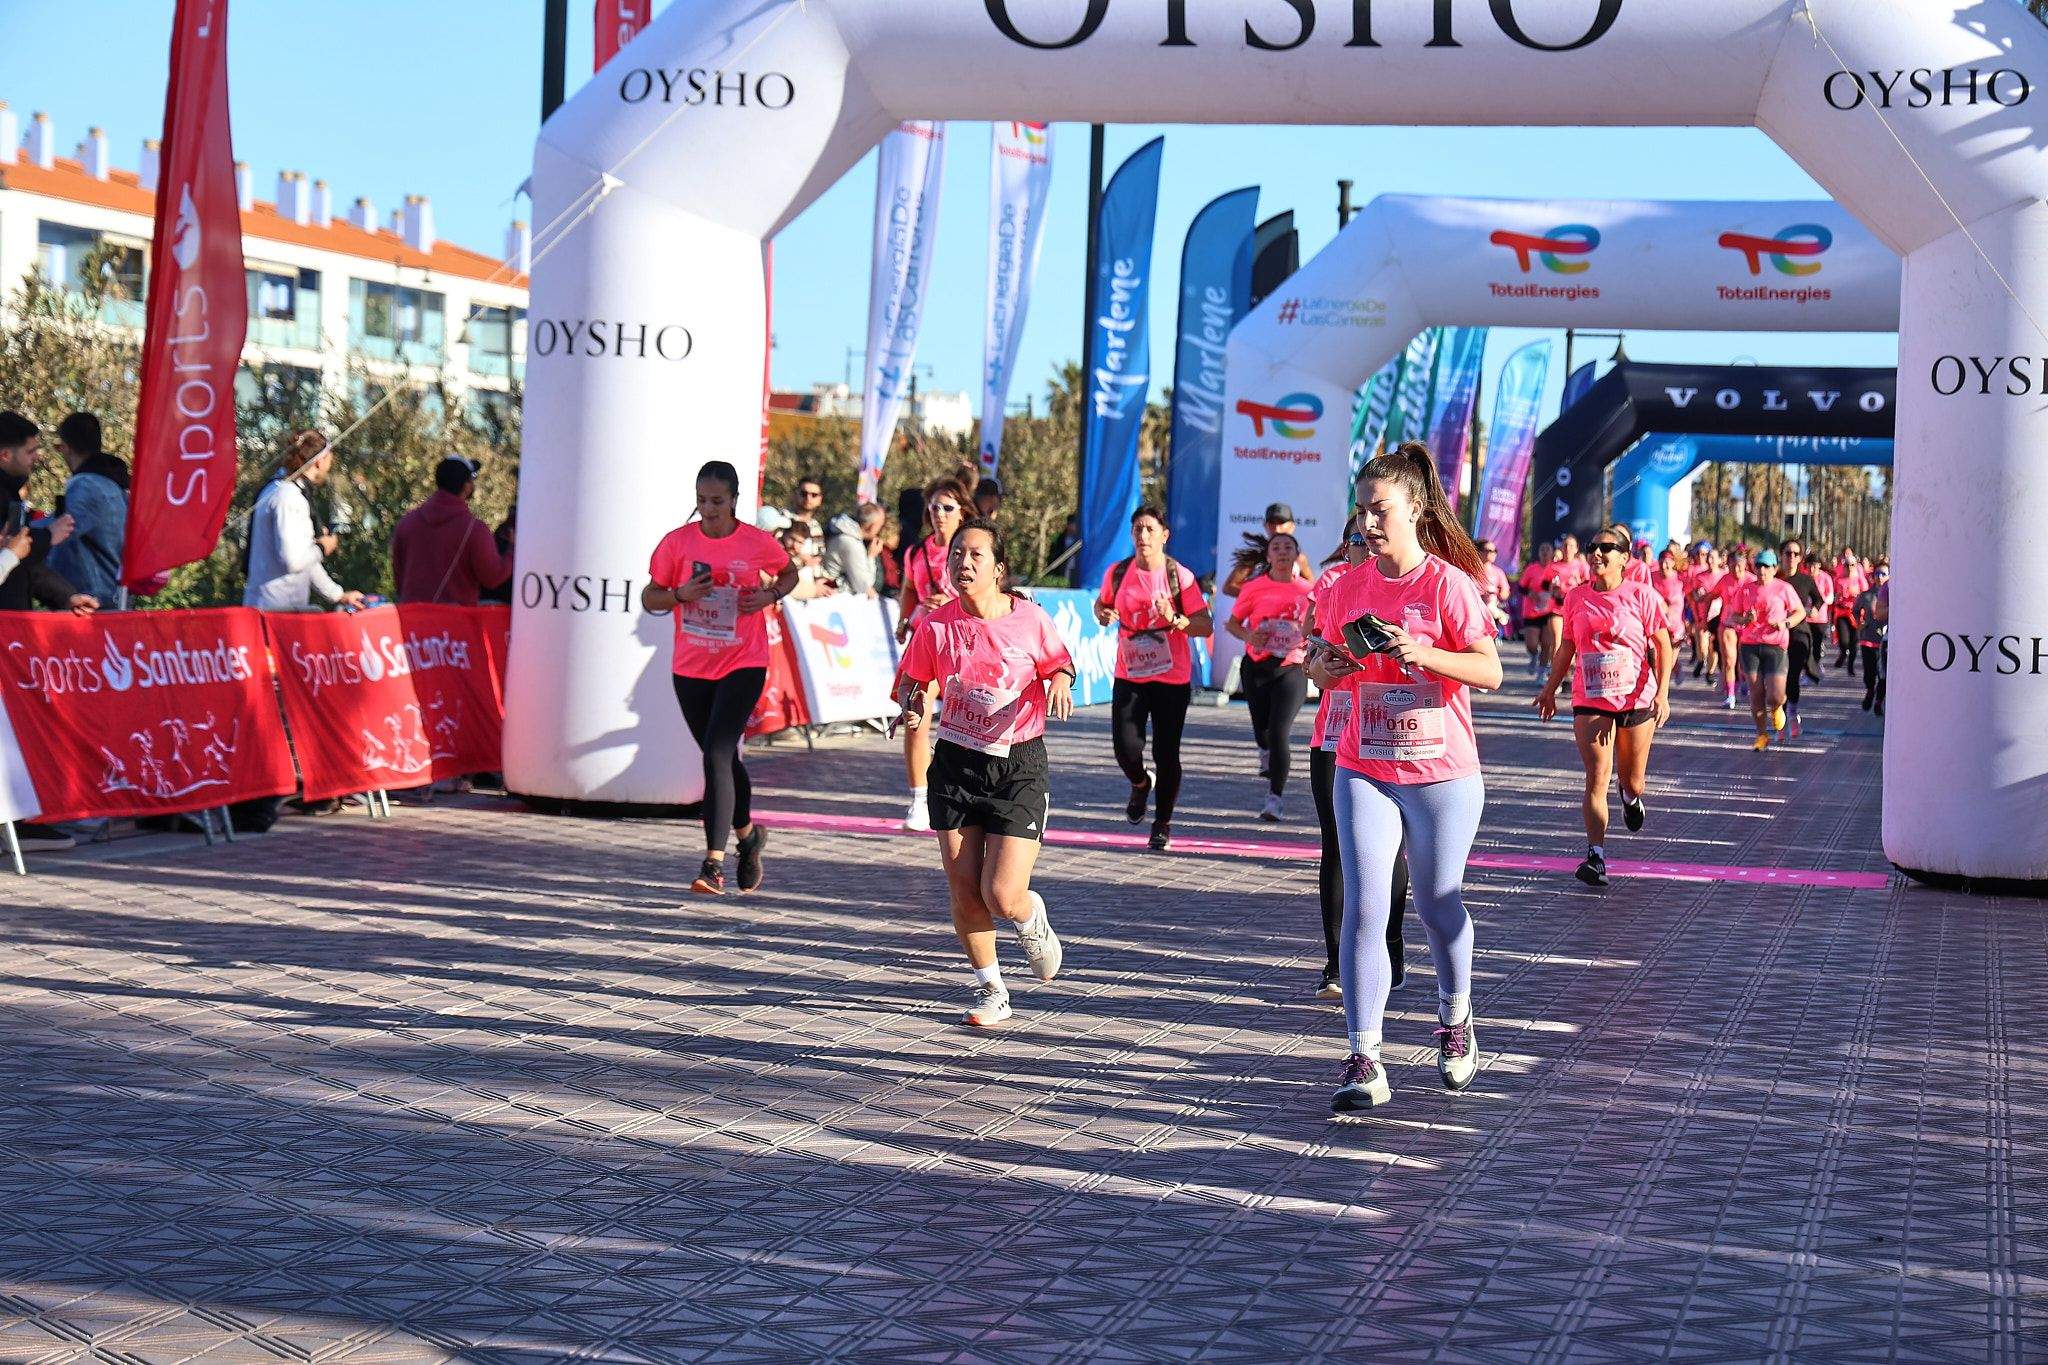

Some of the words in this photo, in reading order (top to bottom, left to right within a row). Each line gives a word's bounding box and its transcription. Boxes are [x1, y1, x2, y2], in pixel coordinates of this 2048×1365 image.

[620, 67, 795, 110] OYSHO
[1823, 68, 2030, 110] OYSHO
[1488, 283, 1600, 301] TotalEnergies
[1717, 286, 1832, 304] TotalEnergies
[534, 318, 693, 361] OYSHO
[1094, 257, 1148, 420] Marlene
[1931, 355, 2048, 396] OYS
[166, 284, 216, 507] Sports
[1664, 386, 1887, 413] VOLVO
[1233, 446, 1321, 465] TotalEnergies
[698, 609, 719, 619] 016
[133, 638, 253, 688] Santander
[292, 641, 362, 697] Sports
[1600, 671, 1619, 680] 016
[966, 711, 992, 727] 016
[1386, 719, 1417, 730] 016
